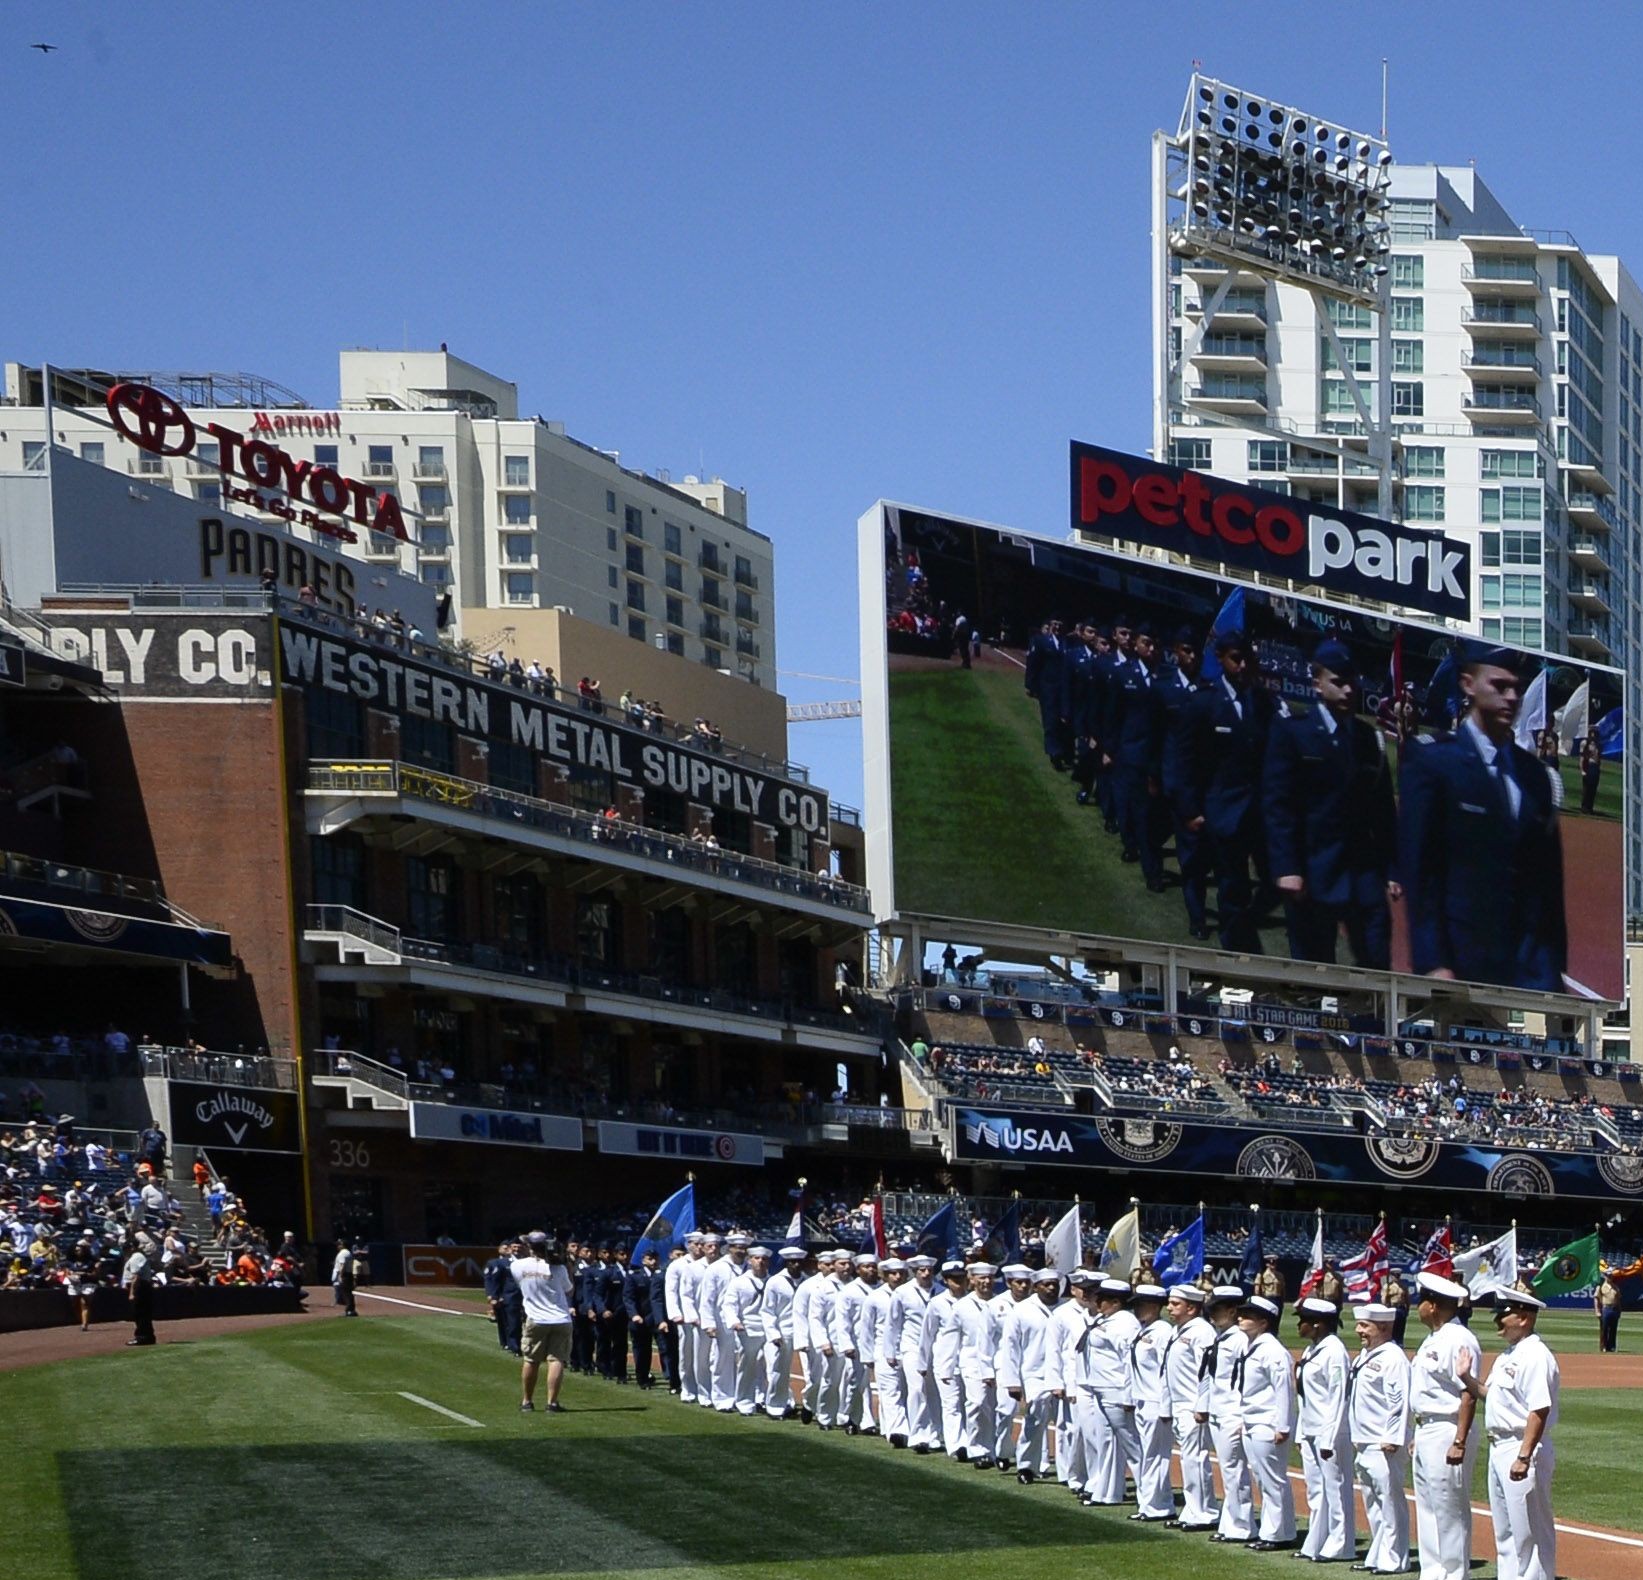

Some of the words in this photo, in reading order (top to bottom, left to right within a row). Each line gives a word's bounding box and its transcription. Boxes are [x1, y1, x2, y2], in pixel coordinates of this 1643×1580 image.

[208, 422, 409, 542] TOYOTA
[269, 497, 297, 522] Go
[301, 509, 358, 545] Places
[200, 518, 356, 617] PADRES
[19, 627, 156, 684] PLY
[178, 628, 272, 687] CO.
[279, 626, 489, 735] WESTERN
[511, 702, 632, 778] METAL
[643, 745, 765, 816] SUPPLY
[778, 788, 827, 837] CO.
[196, 1090, 275, 1129] Callaway
[329, 1138, 370, 1168] 336
[1003, 1127, 1074, 1153] USAA
